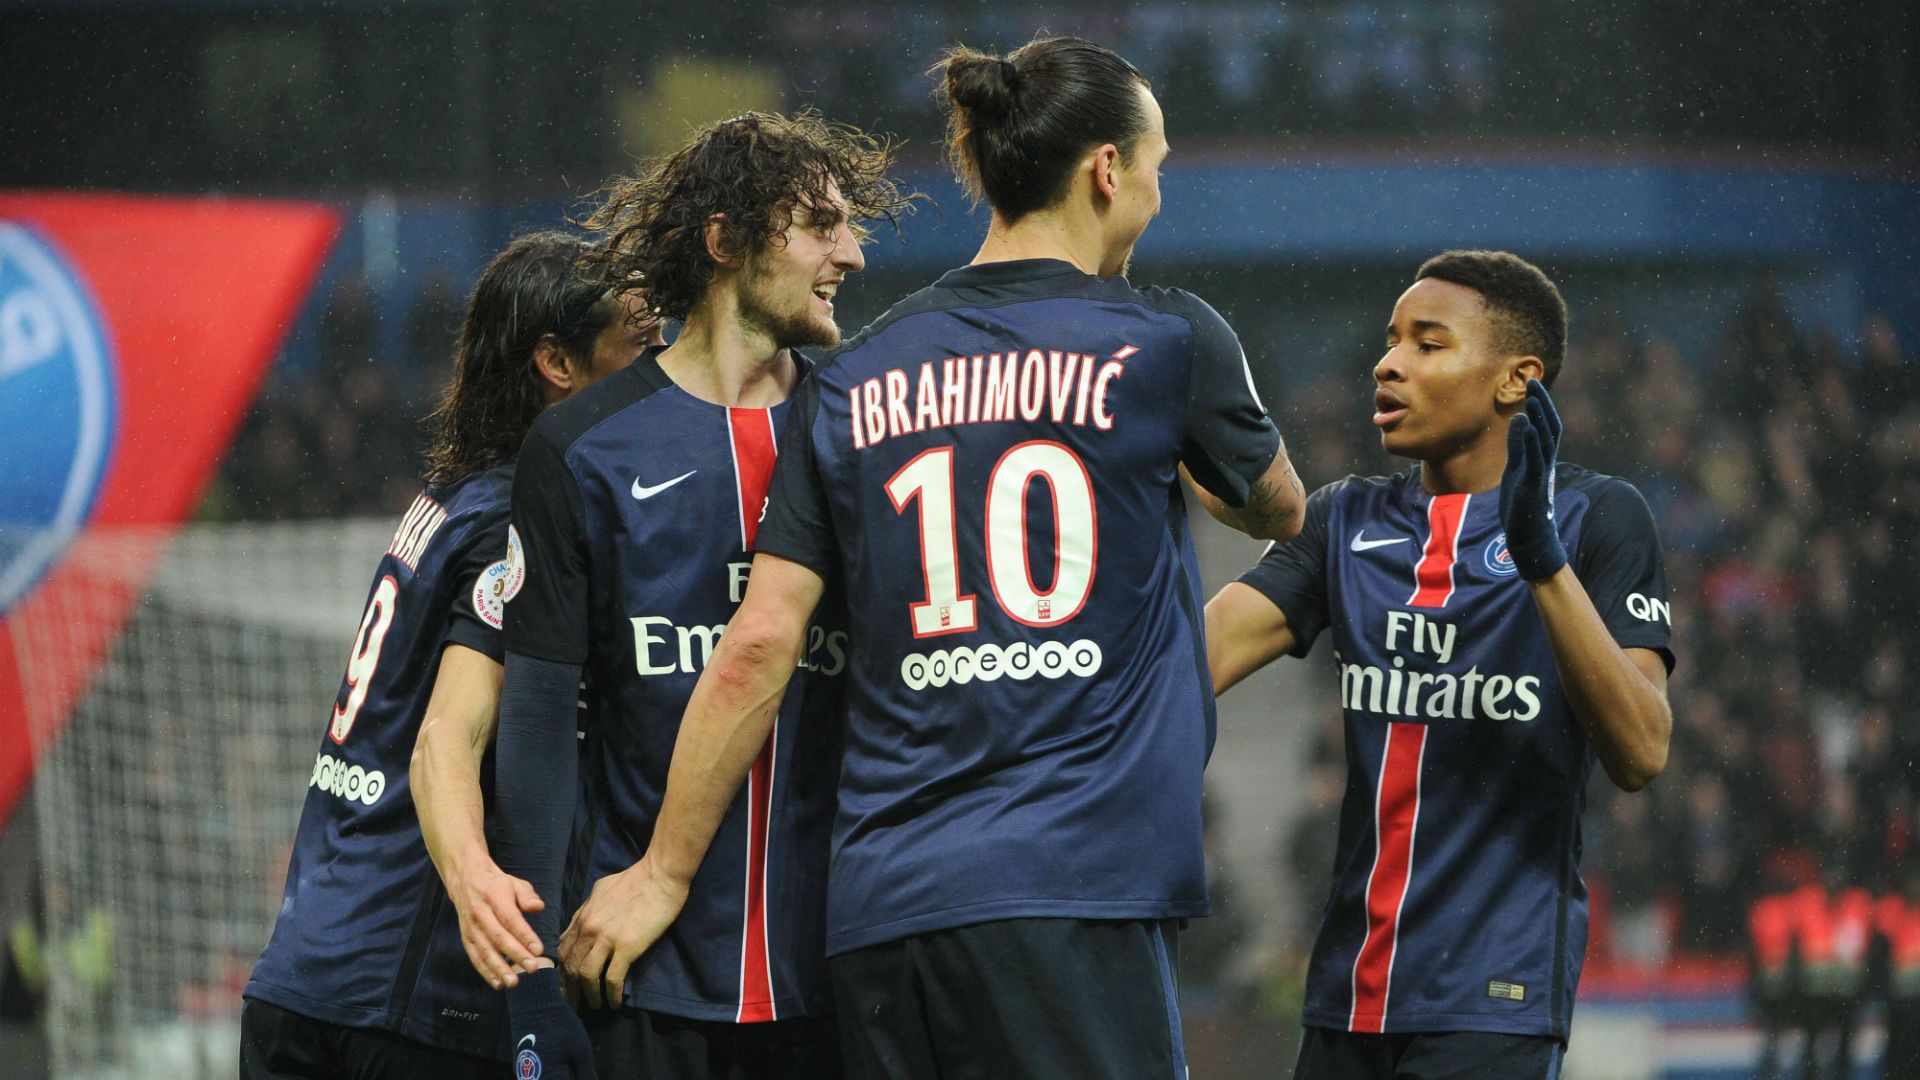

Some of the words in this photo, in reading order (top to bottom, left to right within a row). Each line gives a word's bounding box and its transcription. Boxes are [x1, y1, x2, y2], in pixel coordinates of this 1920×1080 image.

[849, 345, 1140, 449] IBRAHIMOVIĆ
[385, 493, 448, 573] AVANI
[883, 439, 1098, 640] 10
[1385, 611, 1457, 664] Fly
[1626, 592, 1672, 628] QN
[329, 575, 399, 746] 9
[901, 638, 1102, 691] ooredoo
[1334, 650, 1542, 722] mirates
